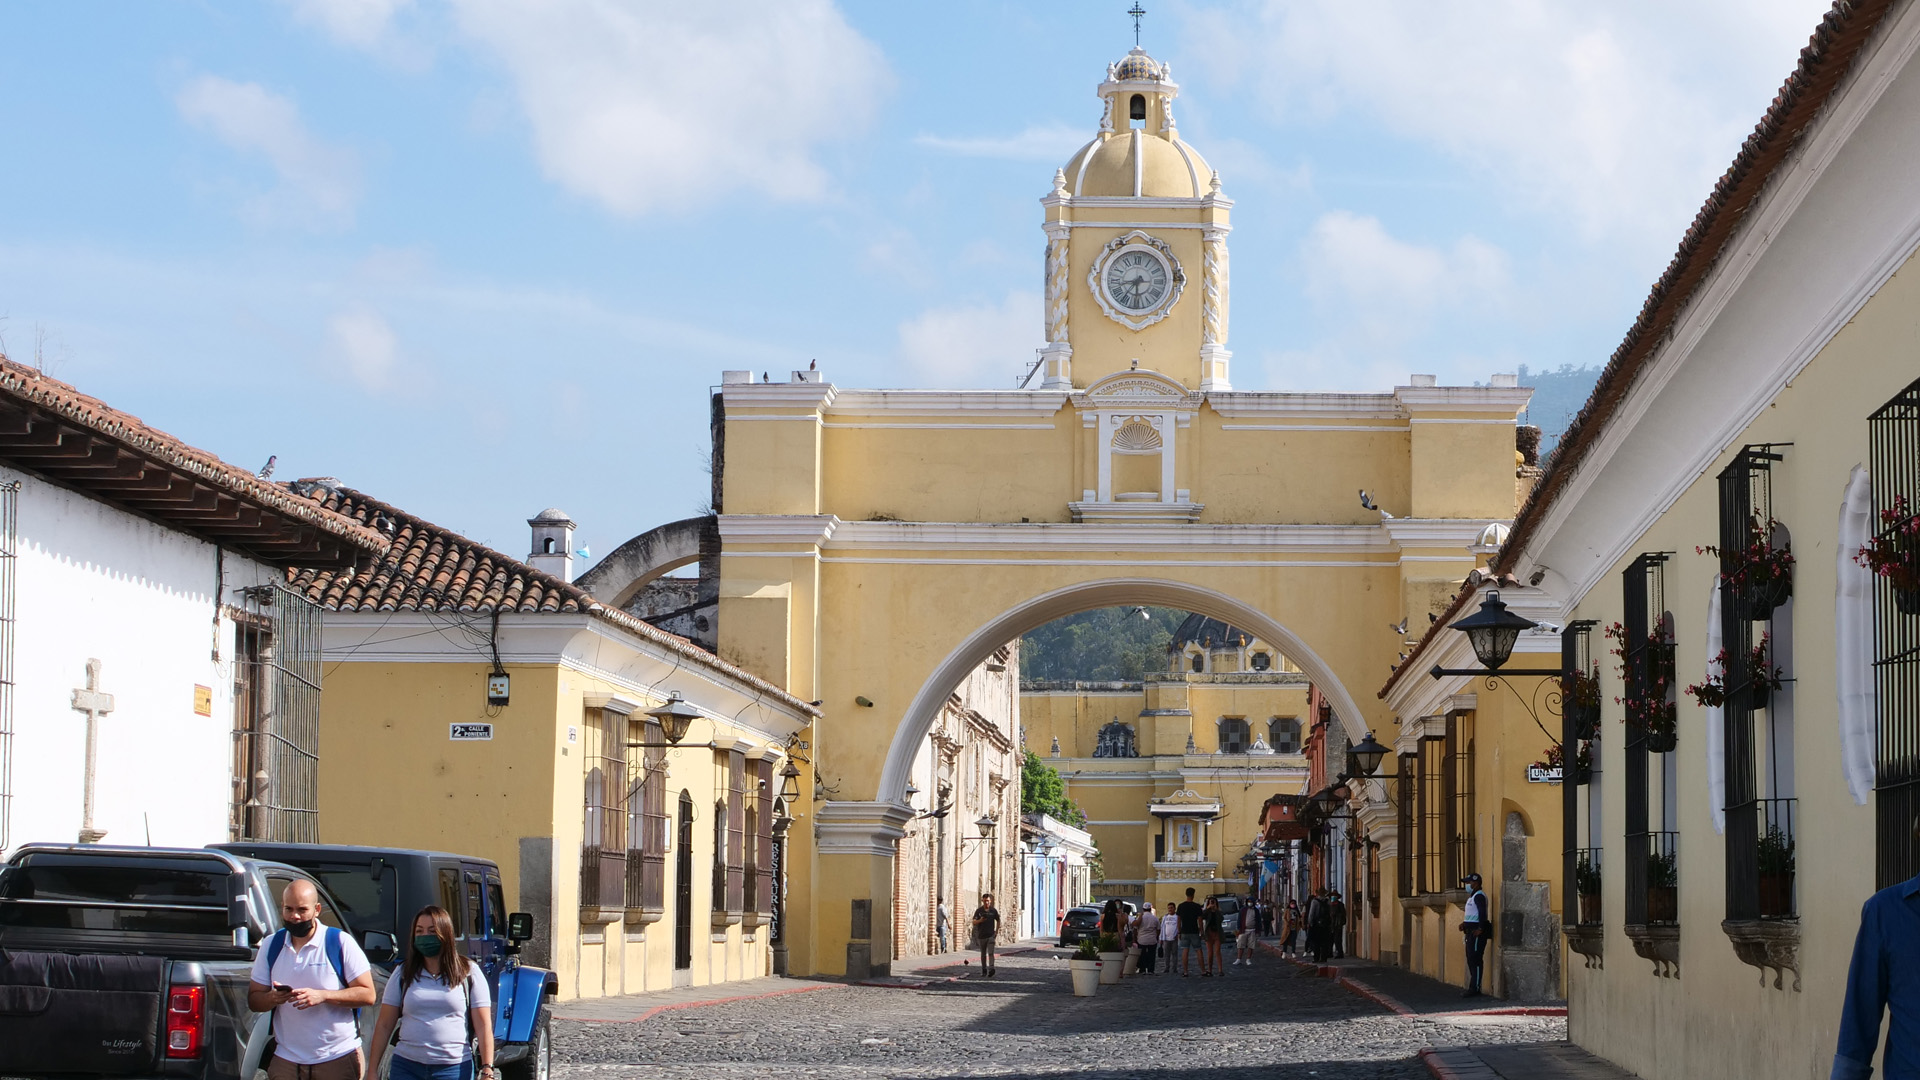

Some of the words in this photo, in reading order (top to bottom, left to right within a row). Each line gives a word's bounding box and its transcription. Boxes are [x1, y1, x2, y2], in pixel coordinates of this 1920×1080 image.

[1534, 769, 1551, 777] UNA
[770, 842, 779, 939] RESTAURANTE
[113, 1039, 142, 1050] Lifestyle
